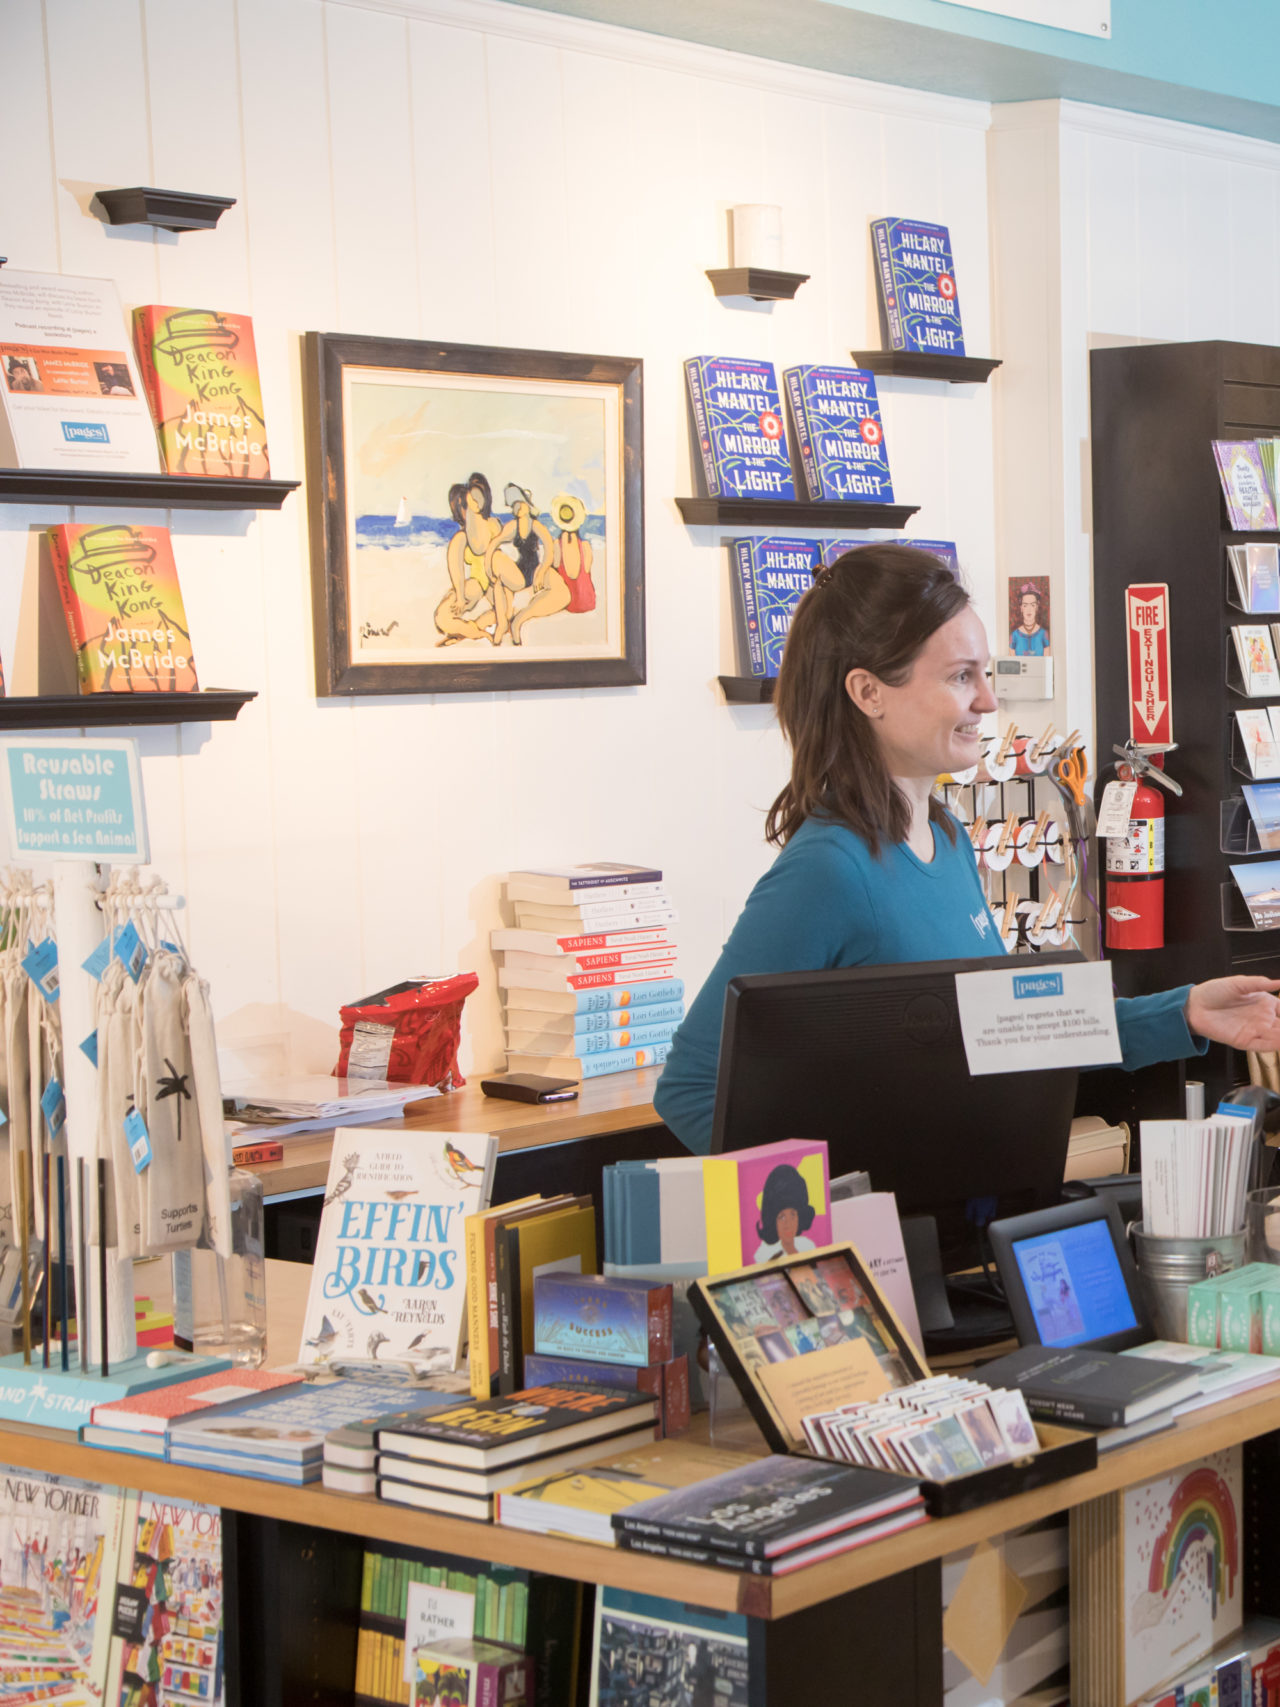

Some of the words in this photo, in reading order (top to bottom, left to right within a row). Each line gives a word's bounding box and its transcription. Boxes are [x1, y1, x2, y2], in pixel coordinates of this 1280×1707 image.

[901, 232, 944, 254] HILARY
[902, 252, 950, 274] MANTEL
[908, 292, 955, 315] MIRROR
[916, 326, 955, 350] LIGHT
[171, 345, 236, 366] Deacon
[716, 371, 768, 391] HILARY
[717, 392, 774, 413] MANTEL
[182, 404, 252, 429] James
[175, 431, 262, 455] McBride
[724, 434, 780, 456] MIRROR
[733, 469, 782, 492] LIGHT
[740, 547, 751, 580] HILARY
[766, 551, 812, 570] HILARY
[87, 564, 155, 584] Deacon
[743, 582, 755, 617] MANTEL
[1136, 605, 1159, 626] FIRE
[105, 622, 176, 643] James
[97, 649, 187, 669] McBride
[1144, 628, 1155, 721] EXTINGUISHER
[23, 753, 115, 775] Reusable
[40, 779, 101, 801] Straws
[50, 808, 60, 823] of
[64, 808, 83, 823] Net
[86, 809, 122, 824] Profits
[73, 830, 93, 845] Sea
[568, 936, 604, 948] SAPIENS
[586, 955, 619, 966] SAPIENS
[1026, 1010, 1054, 1021] regrets
[1056, 1009, 1073, 1017] that
[997, 1023, 1024, 1034] unable
[1026, 1022, 1034, 1031] to
[1036, 1021, 1060, 1032] accept
[1062, 1019, 1081, 1028] $100
[976, 1037, 1002, 1047] Thank
[1004, 1037, 1018, 1046] you
[1020, 1034, 1031, 1043] for
[1033, 1033, 1051, 1043] your
[160, 1203, 198, 1221] Supports
[337, 1200, 465, 1244] EFFIN'
[166, 1220, 193, 1234] Turtles
[324, 1246, 457, 1299] BIRDS
[569, 1322, 613, 1338] SUCCESS
[0, 1383, 25, 1404] AND
[43, 1392, 101, 1414] STRAW
[426, 1407, 546, 1435] BEGIN
[4, 1478, 40, 1504] NEW
[42, 1486, 100, 1519] YORKER
[624, 1521, 635, 1531] Los
[636, 1523, 661, 1535] Angeles
[420, 1612, 455, 1629] RATHER
